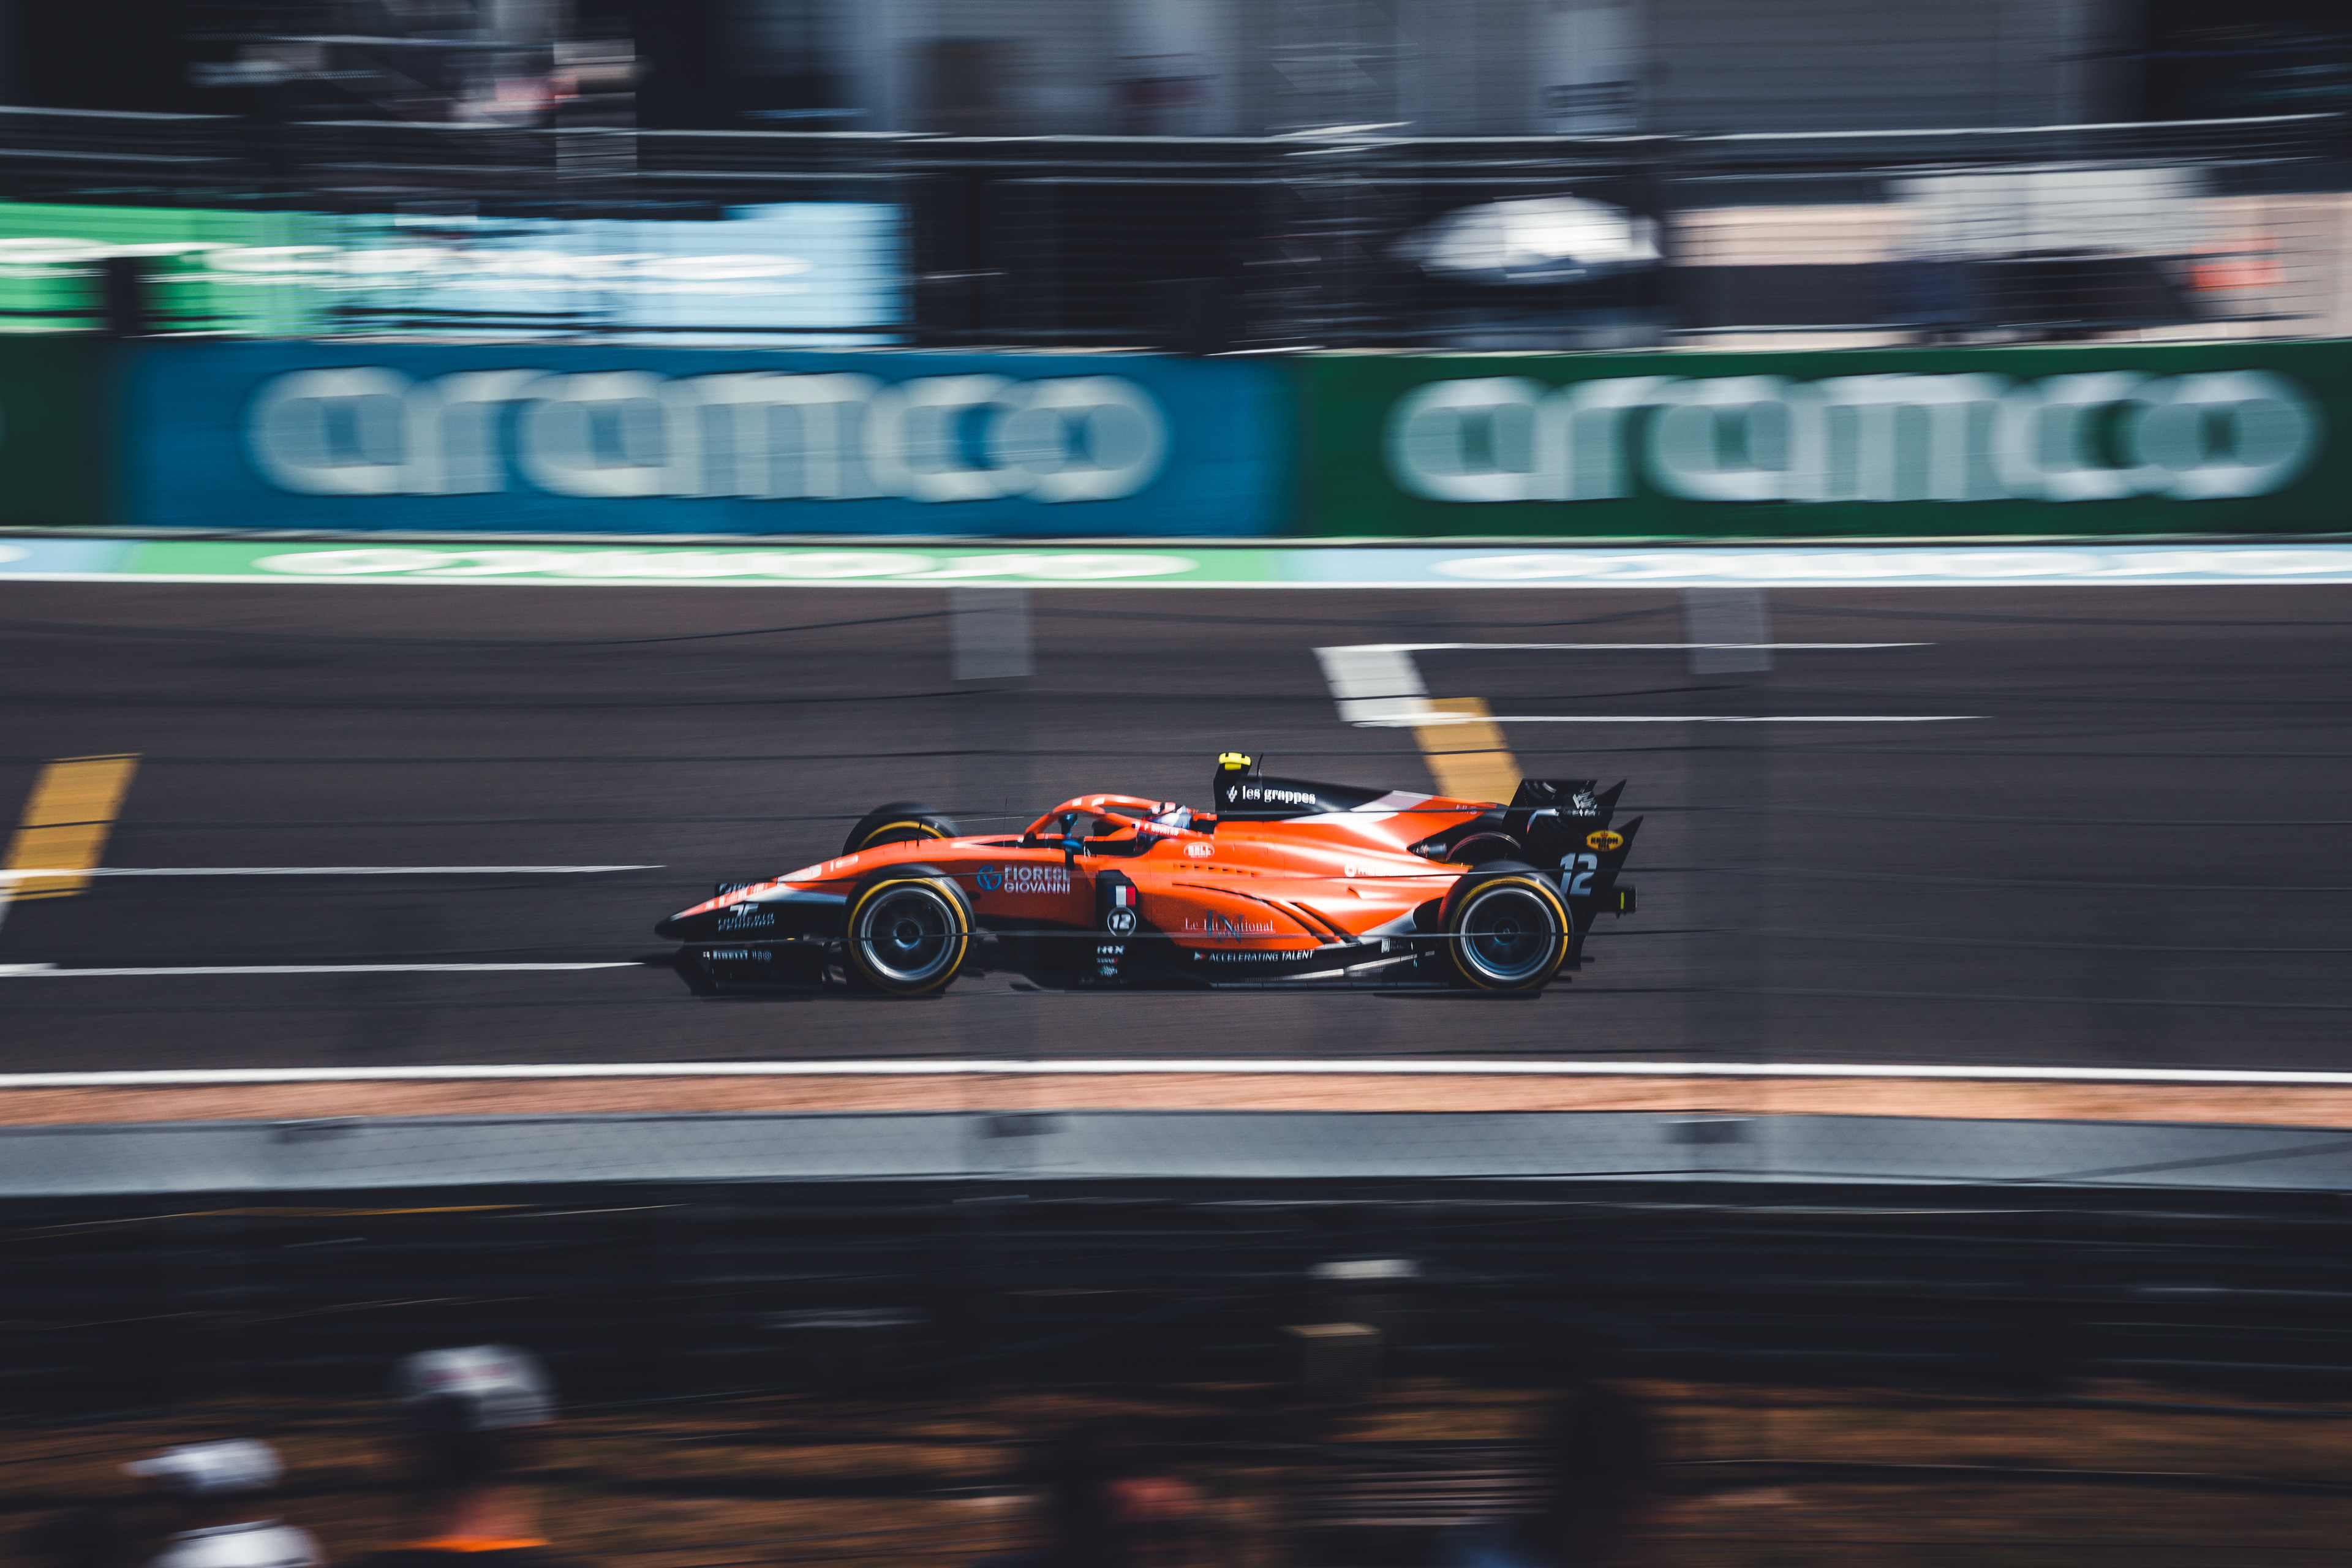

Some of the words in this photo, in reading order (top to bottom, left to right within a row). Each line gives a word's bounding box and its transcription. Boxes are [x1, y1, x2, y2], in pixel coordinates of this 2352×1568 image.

[246, 366, 1169, 503] aramco
[1390, 369, 2318, 503] aramco
[1242, 785, 1261, 800] les
[1264, 789, 1316, 804] grappes
[1560, 852, 1597, 896] 12
[1004, 880, 1071, 894] GIOVANNI
[1112, 913, 1131, 930] 12
[1209, 952, 1279, 962] ACCELERATING
[1281, 949, 1315, 961] TALENT
